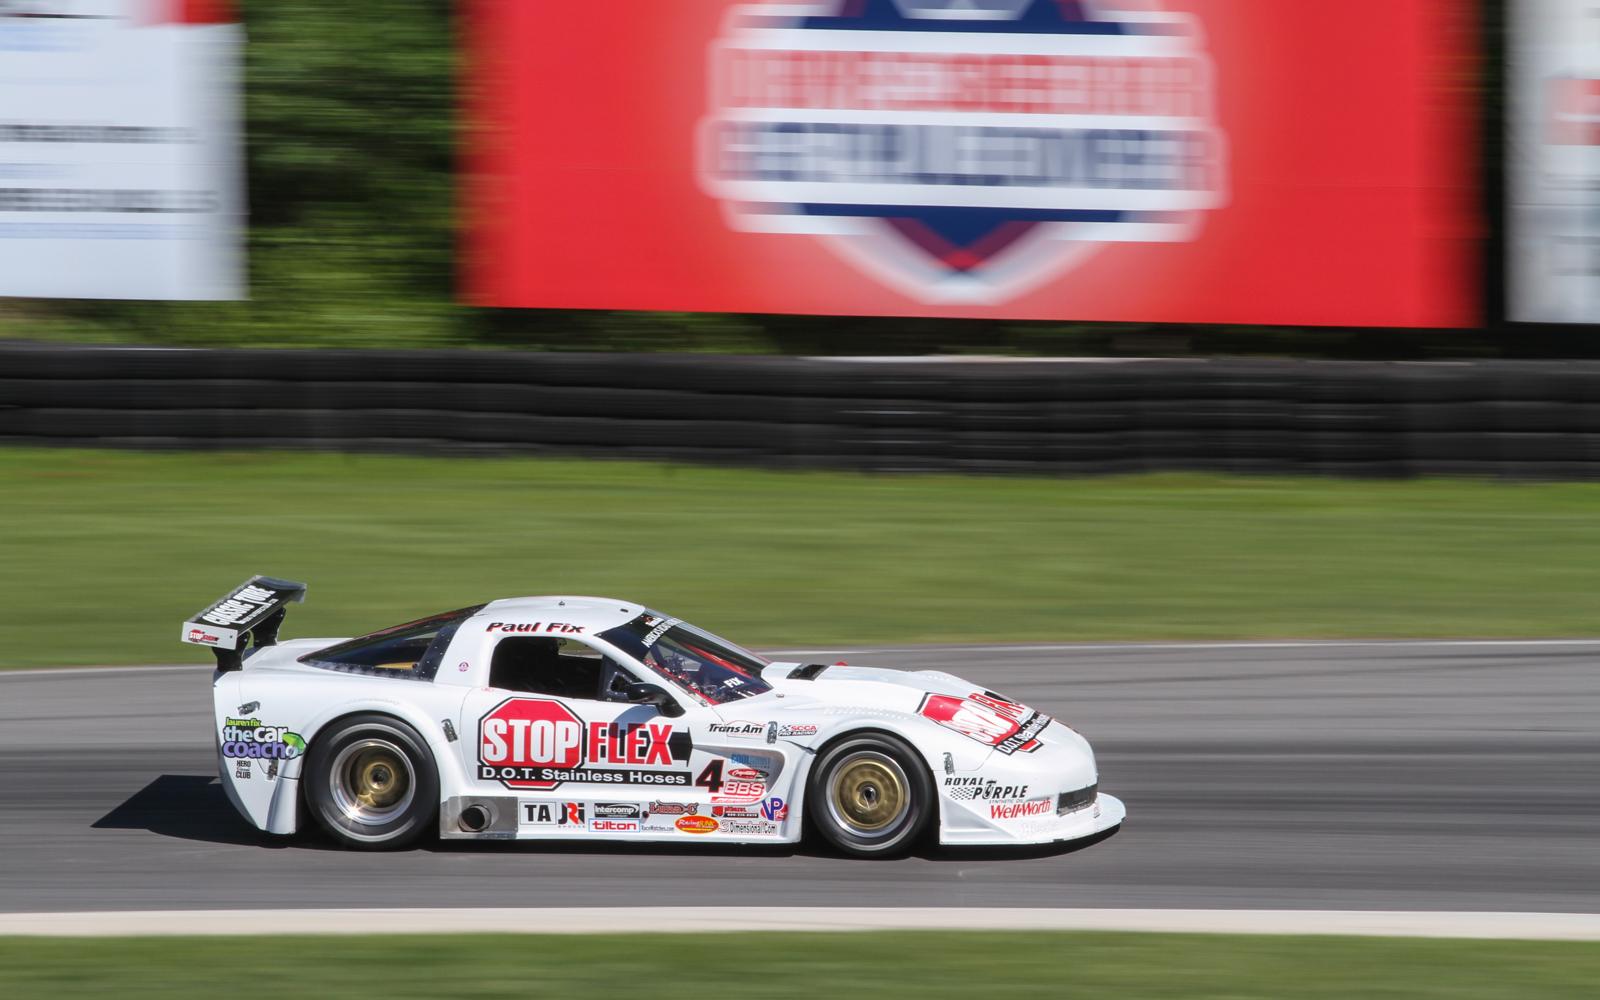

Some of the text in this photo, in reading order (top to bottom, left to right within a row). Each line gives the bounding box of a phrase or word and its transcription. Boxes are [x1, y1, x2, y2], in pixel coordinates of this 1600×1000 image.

[201, 597, 255, 626] CLASSIC
[486, 622, 585, 633] Paul Fix
[723, 677, 744, 688] FIX
[709, 723, 763, 733] Trans Am
[223, 741, 286, 758] coach
[483, 718, 673, 766] STOP FLEX
[236, 771, 251, 779] CLUB
[482, 766, 686, 785] D.O.T. Stainless Hoses
[695, 759, 724, 793] 4
[945, 777, 984, 786] ROYAL
[724, 782, 765, 796] BBS
[972, 782, 1028, 800] PURPLE
[524, 805, 551, 822] TA
[761, 797, 784, 821] VP
[592, 821, 637, 830] tilton
